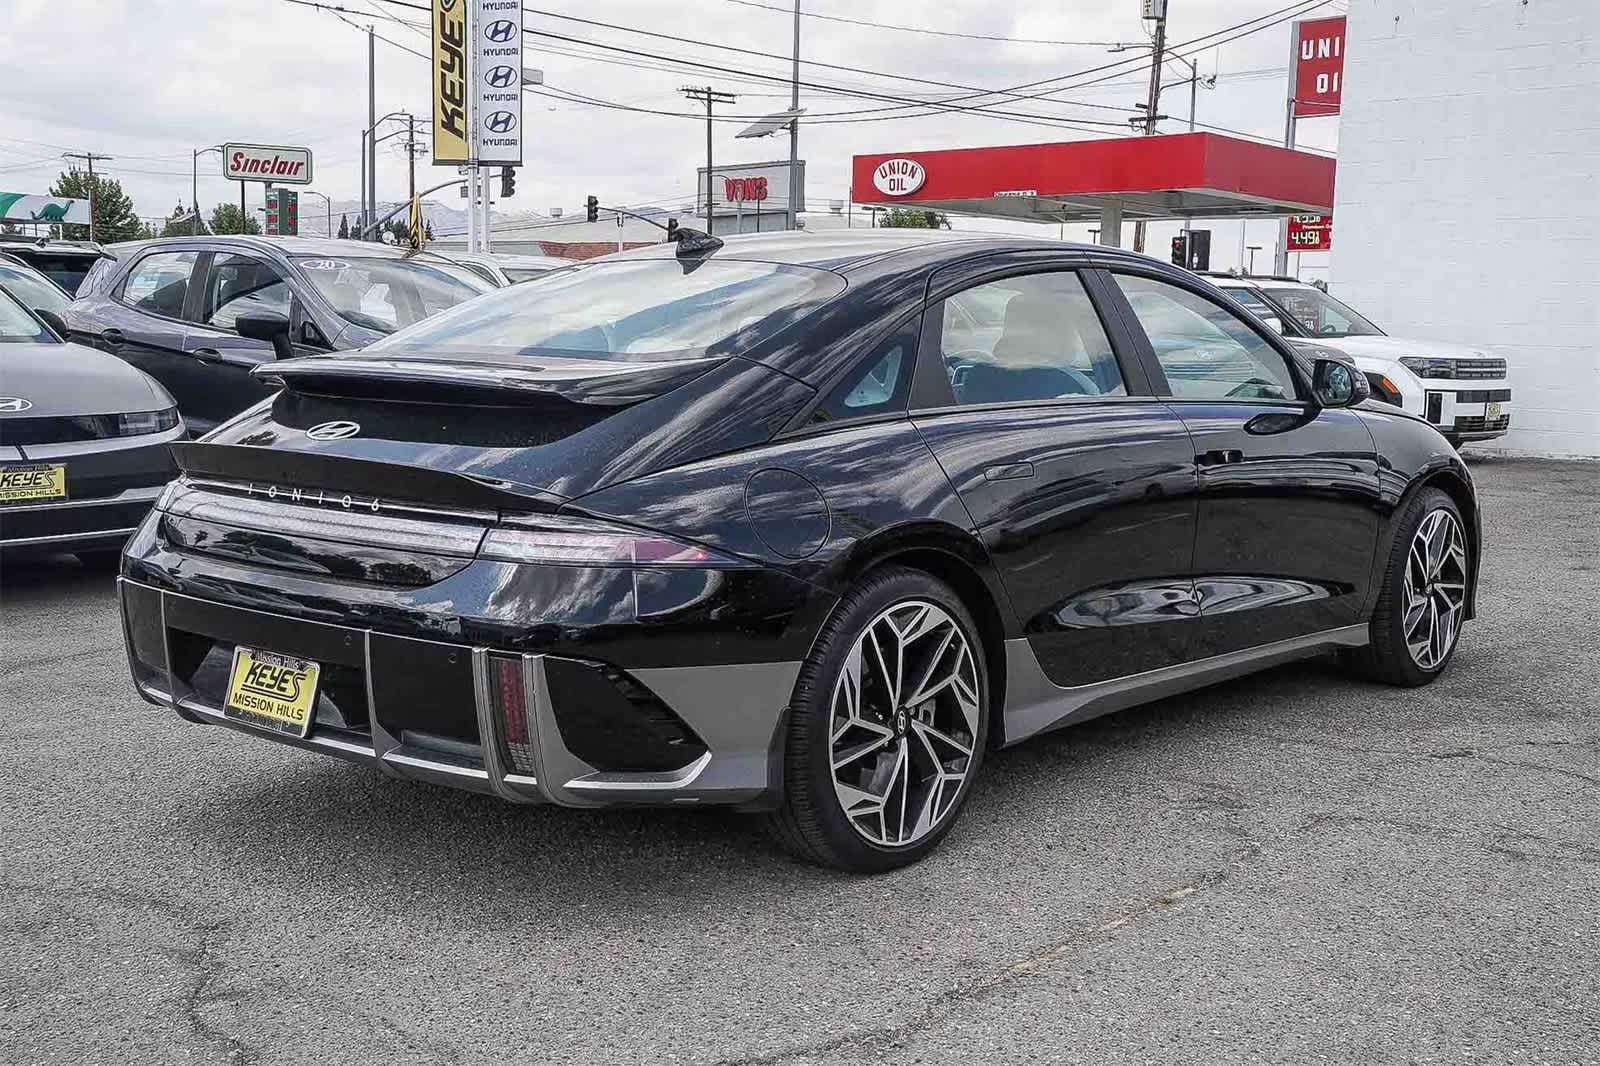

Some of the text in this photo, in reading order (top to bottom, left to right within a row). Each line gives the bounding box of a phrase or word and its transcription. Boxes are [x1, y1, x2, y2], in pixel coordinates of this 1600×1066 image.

[483, 2, 518, 10] HYUNDAI
[483, 48, 518, 56] HYUNDAI
[1302, 36, 1340, 60] UNI
[1316, 72, 1339, 93] OI
[483, 138, 518, 146] HYUNDAI
[230, 152, 304, 175] Sinclair
[879, 161, 918, 179] UNION
[889, 178, 907, 191] OIL
[0, 471, 57, 489] KEYES
[243, 662, 307, 702] KEYES
[233, 693, 273, 712] MISSION
[276, 704, 304, 721] HILLS
